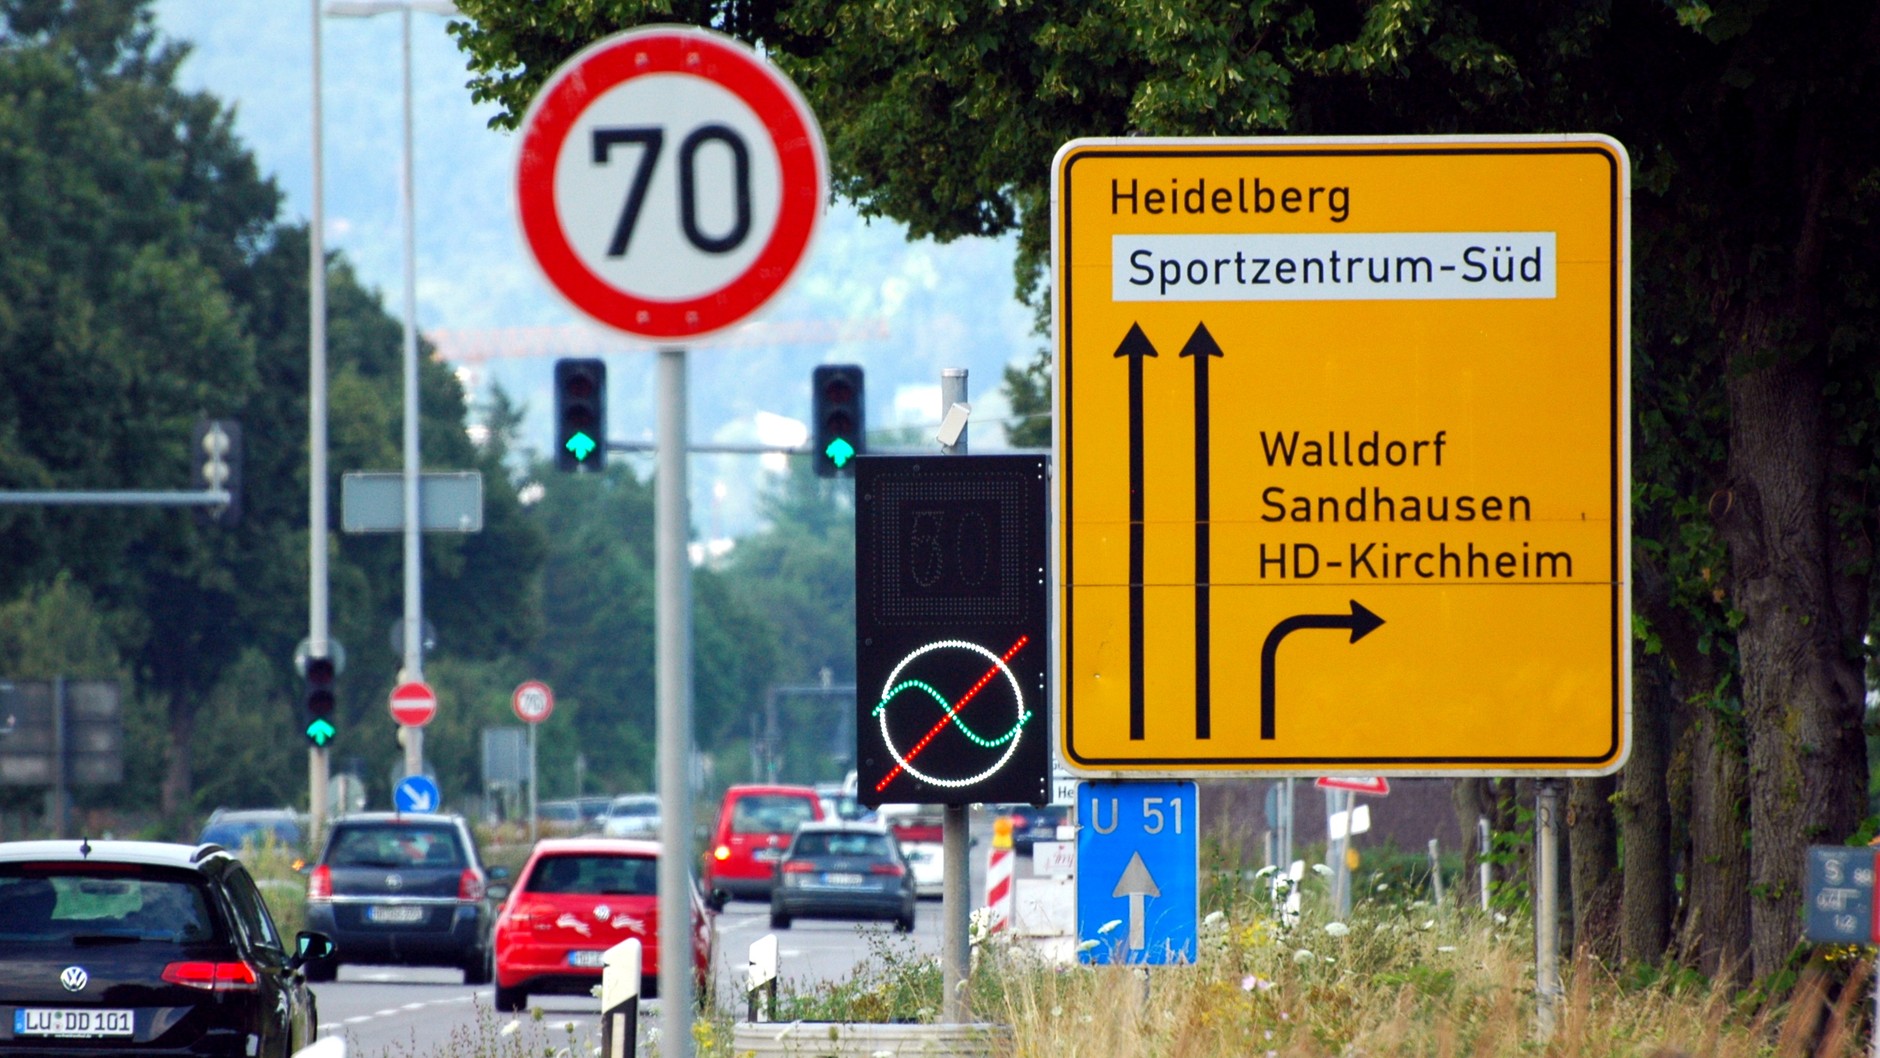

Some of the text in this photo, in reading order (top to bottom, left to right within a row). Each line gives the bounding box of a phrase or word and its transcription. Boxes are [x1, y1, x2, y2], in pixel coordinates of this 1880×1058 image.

[591, 121, 753, 258] 70
[1110, 177, 1351, 223] Heidelberg
[1128, 245, 1544, 295] Sportzentrum-Süd
[1259, 430, 1448, 467] Walldorf
[1259, 486, 1533, 522] Sandhausen
[1258, 542, 1575, 579] HD-Kirchheim
[1091, 797, 1183, 835] U 51
[1825, 859, 1843, 884] S
[26, 1012, 131, 1032] LU DD 101
